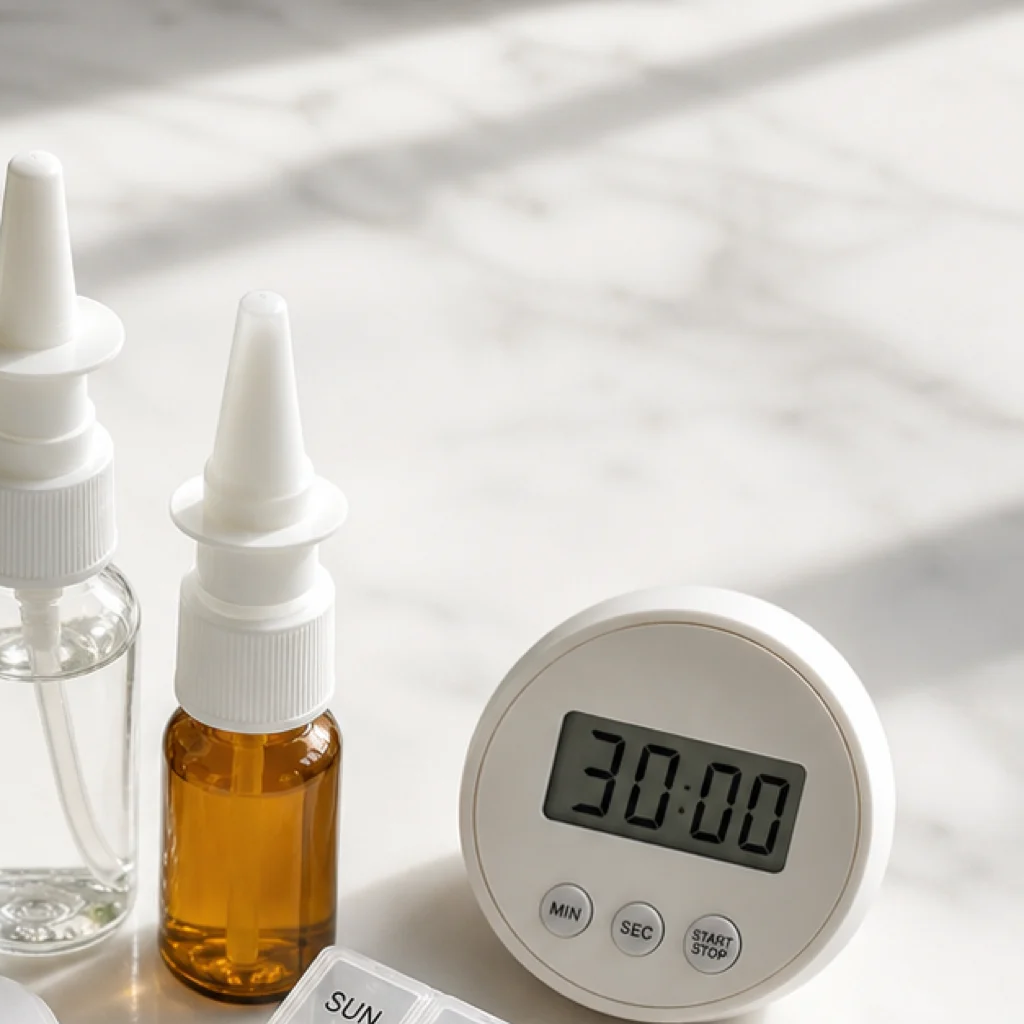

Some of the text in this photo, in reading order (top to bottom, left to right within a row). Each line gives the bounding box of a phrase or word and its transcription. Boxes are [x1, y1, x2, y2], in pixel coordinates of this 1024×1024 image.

[571, 729, 791, 856] 30:00
[549, 901, 581, 922] MIN
[619, 920, 653, 940] SEC
[691, 928, 733, 948] START
[690, 942, 727, 960] STOP
